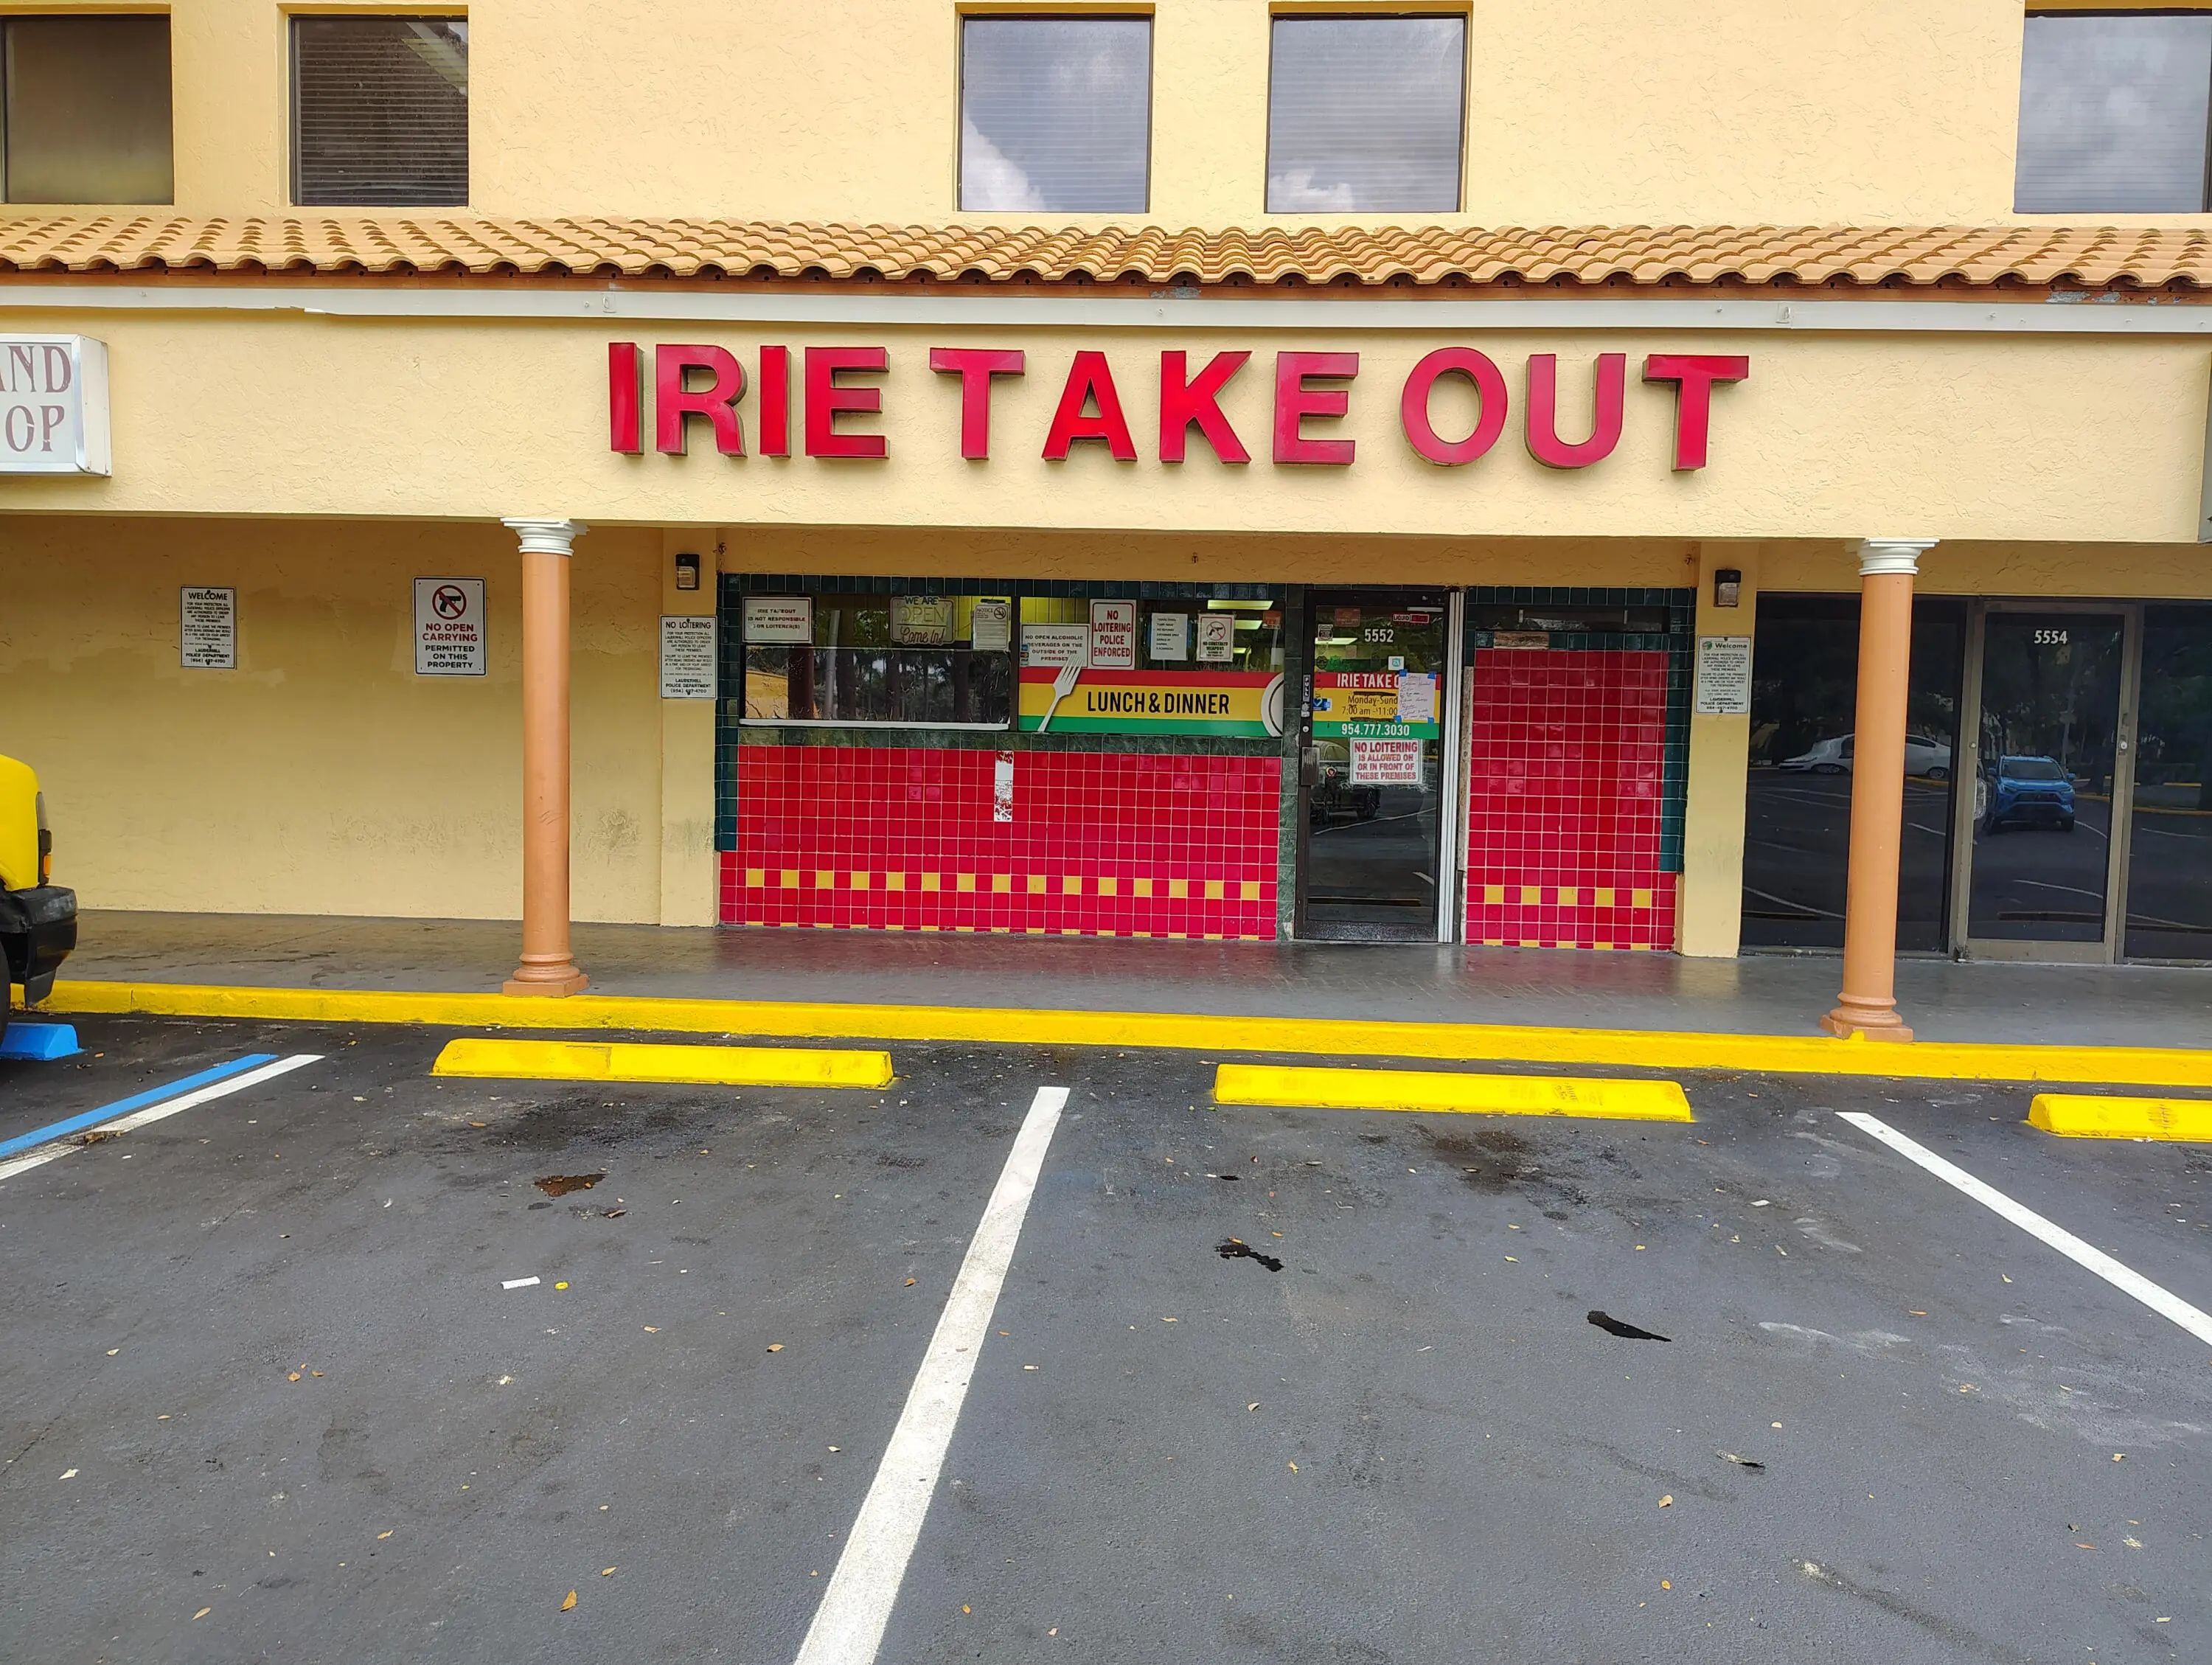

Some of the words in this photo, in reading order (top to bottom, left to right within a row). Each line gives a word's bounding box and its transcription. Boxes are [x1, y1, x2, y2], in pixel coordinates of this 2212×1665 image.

[608, 342, 889, 459] IRIE
[930, 347, 1360, 465] TAKE
[1401, 346, 1750, 470] OUT
[5, 405, 65, 452] OP
[188, 592, 228, 600] WELCOME
[905, 597, 919, 605] WE
[900, 606, 944, 622] OPEN
[1107, 610, 1119, 619] NO
[425, 623, 442, 631] NO
[445, 624, 474, 632] OPEN
[1094, 622, 1131, 633] LOITERING
[422, 633, 478, 642] CARRYING
[900, 626, 928, 644] Come
[1100, 635, 1125, 644] POLICE
[1364, 628, 1394, 643] 5552
[2034, 630, 2067, 644] 5554
[1093, 647, 1130, 657] ENFORCED
[1337, 673, 1360, 687] IRIE
[1363, 673, 1392, 688] TAKE
[1088, 691, 1145, 712] LUNCH
[1149, 692, 1161, 713] &
[1164, 693, 1229, 715] DINNER
[1348, 695, 1398, 706] Monday-Sund
[1342, 723, 1410, 736] 954.777.3030
[1354, 743, 1367, 752] NO
[1370, 743, 1418, 752] LOITERING
